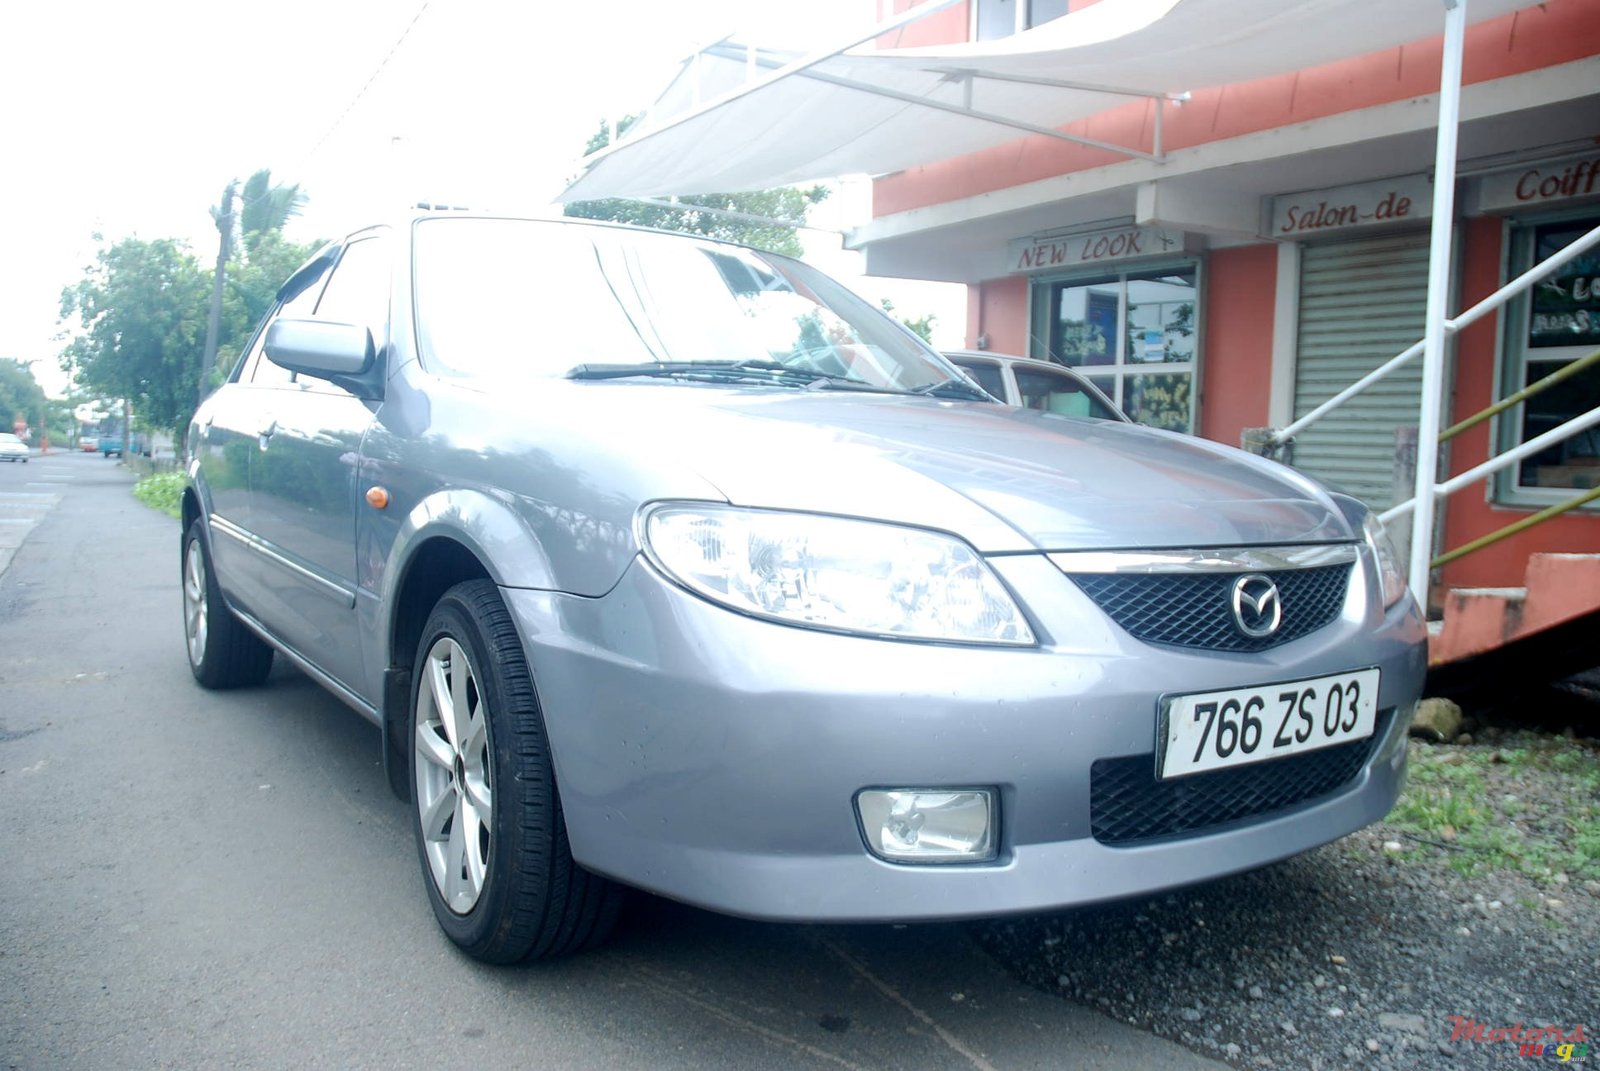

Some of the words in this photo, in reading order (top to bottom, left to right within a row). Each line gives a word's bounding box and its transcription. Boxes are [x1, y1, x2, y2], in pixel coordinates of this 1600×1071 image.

[1281, 201, 1358, 233] Salon
[1374, 191, 1412, 220] de
[1017, 241, 1067, 269] NEW
[1081, 231, 1144, 261] LOOK
[1192, 695, 1265, 763] 766
[1273, 687, 1317, 748] ZS
[1324, 679, 1361, 737] 03
